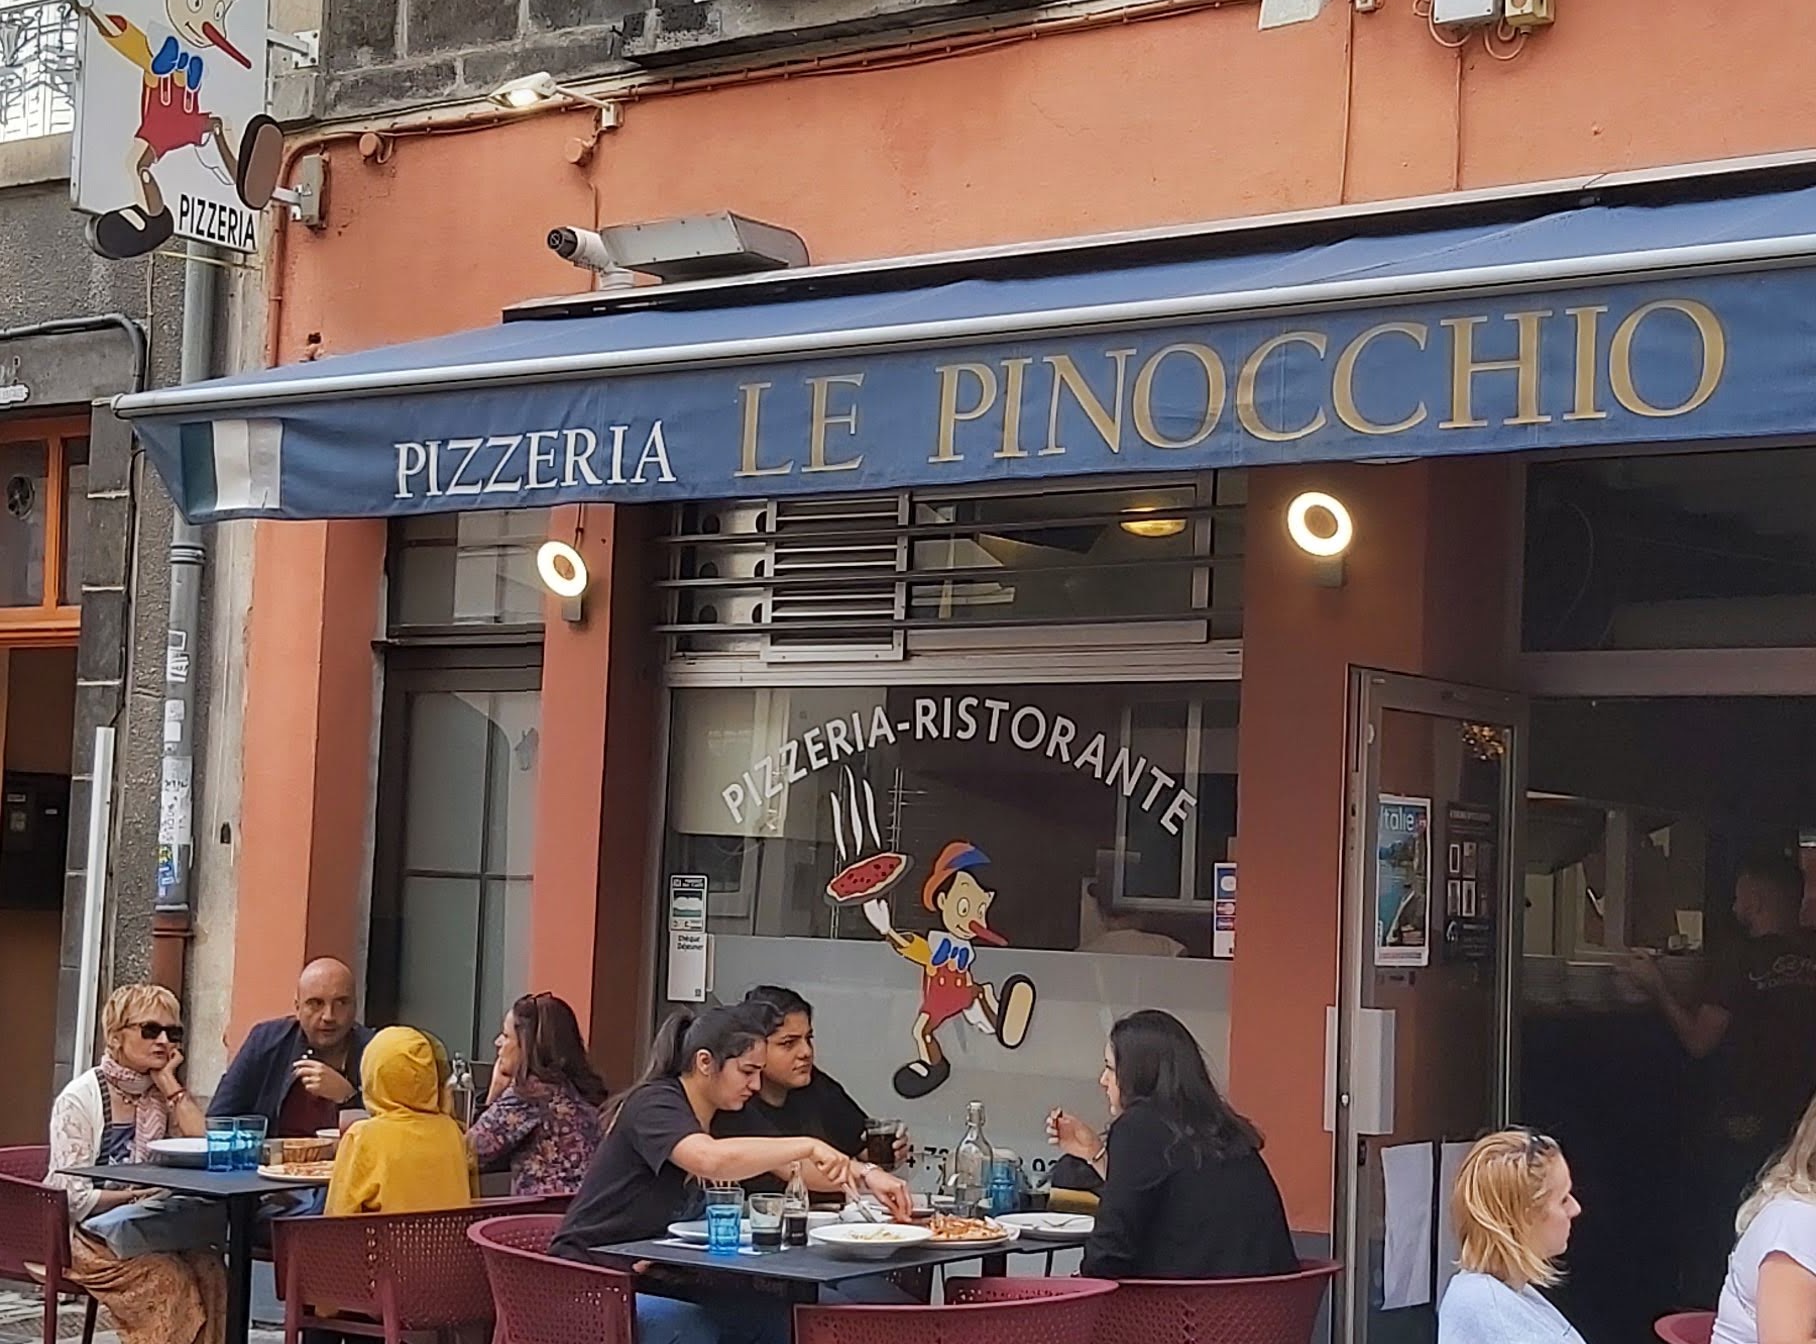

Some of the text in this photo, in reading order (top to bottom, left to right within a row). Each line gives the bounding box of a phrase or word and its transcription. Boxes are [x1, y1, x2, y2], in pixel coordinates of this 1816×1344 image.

[179, 193, 257, 251] PIZZERIA
[393, 298, 1726, 499] PIZZERIA LE PINOCCHIO
[721, 694, 1198, 837] PIZZERIA-RISTORANTE
